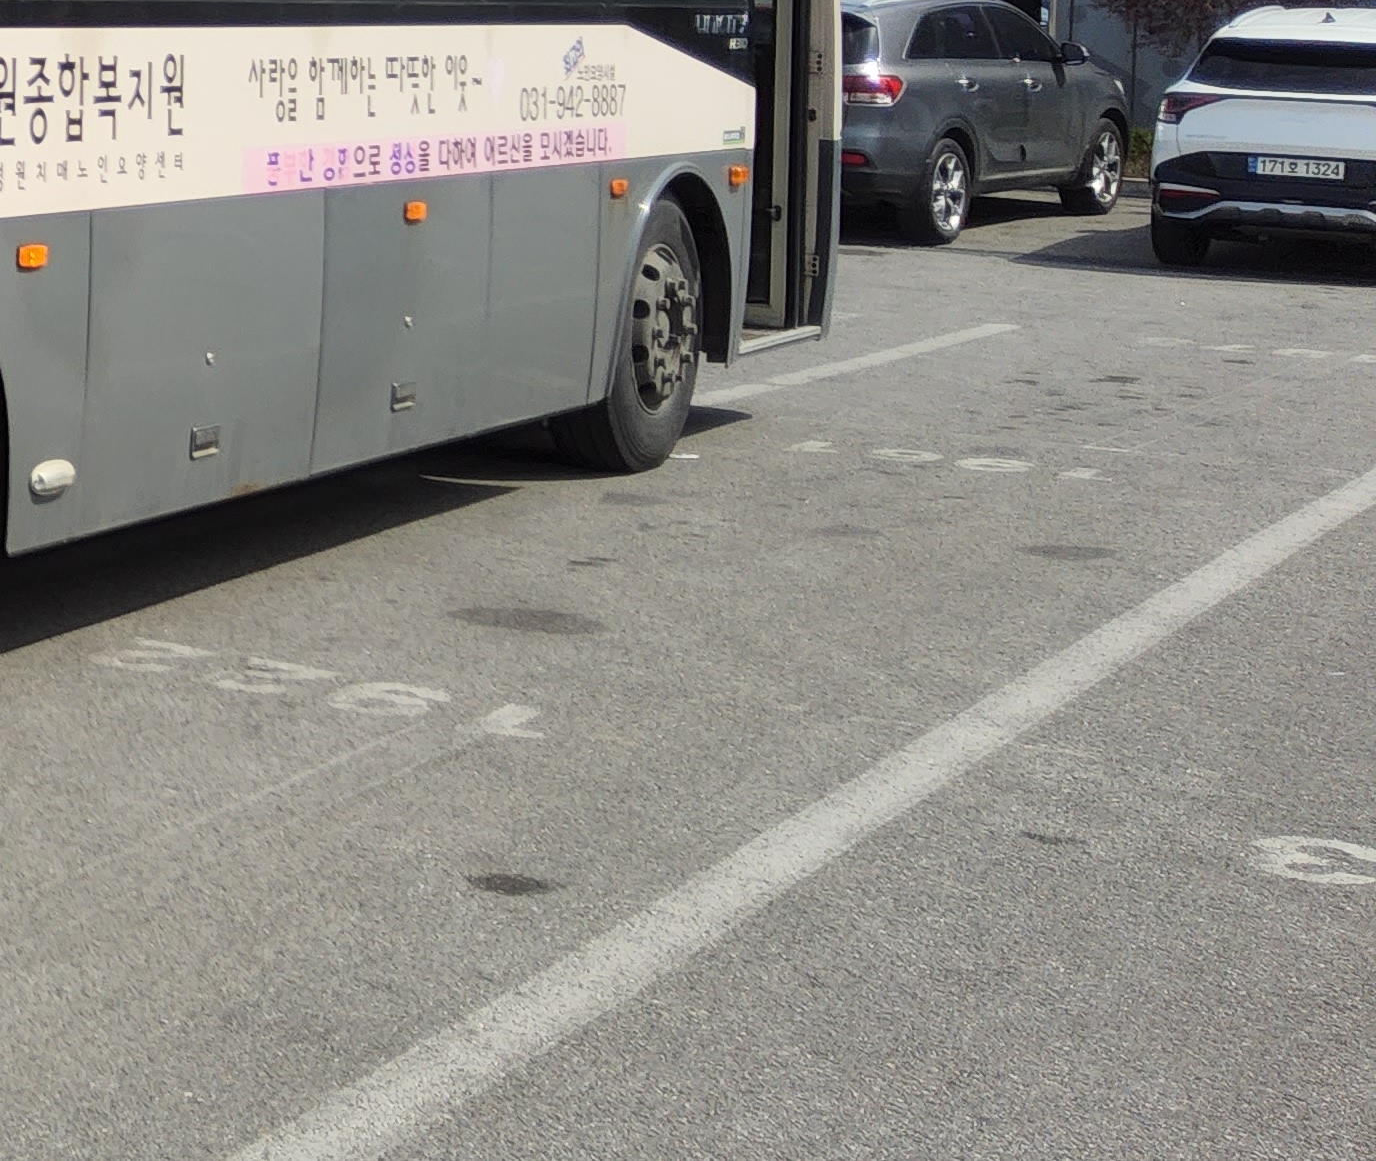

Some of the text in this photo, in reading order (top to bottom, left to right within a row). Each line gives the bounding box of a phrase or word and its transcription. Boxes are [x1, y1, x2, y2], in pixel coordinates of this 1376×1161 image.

[248, 57, 298, 122] 사랑을
[309, 56, 376, 120] 함께하는
[385, 55, 436, 114] 따뜻한
[520, 84, 626, 121] 031-942-8887
[438, 137, 477, 170] 다하여
[484, 133, 533, 167] 어르신을
[1303, 162, 1340, 177] 1324
